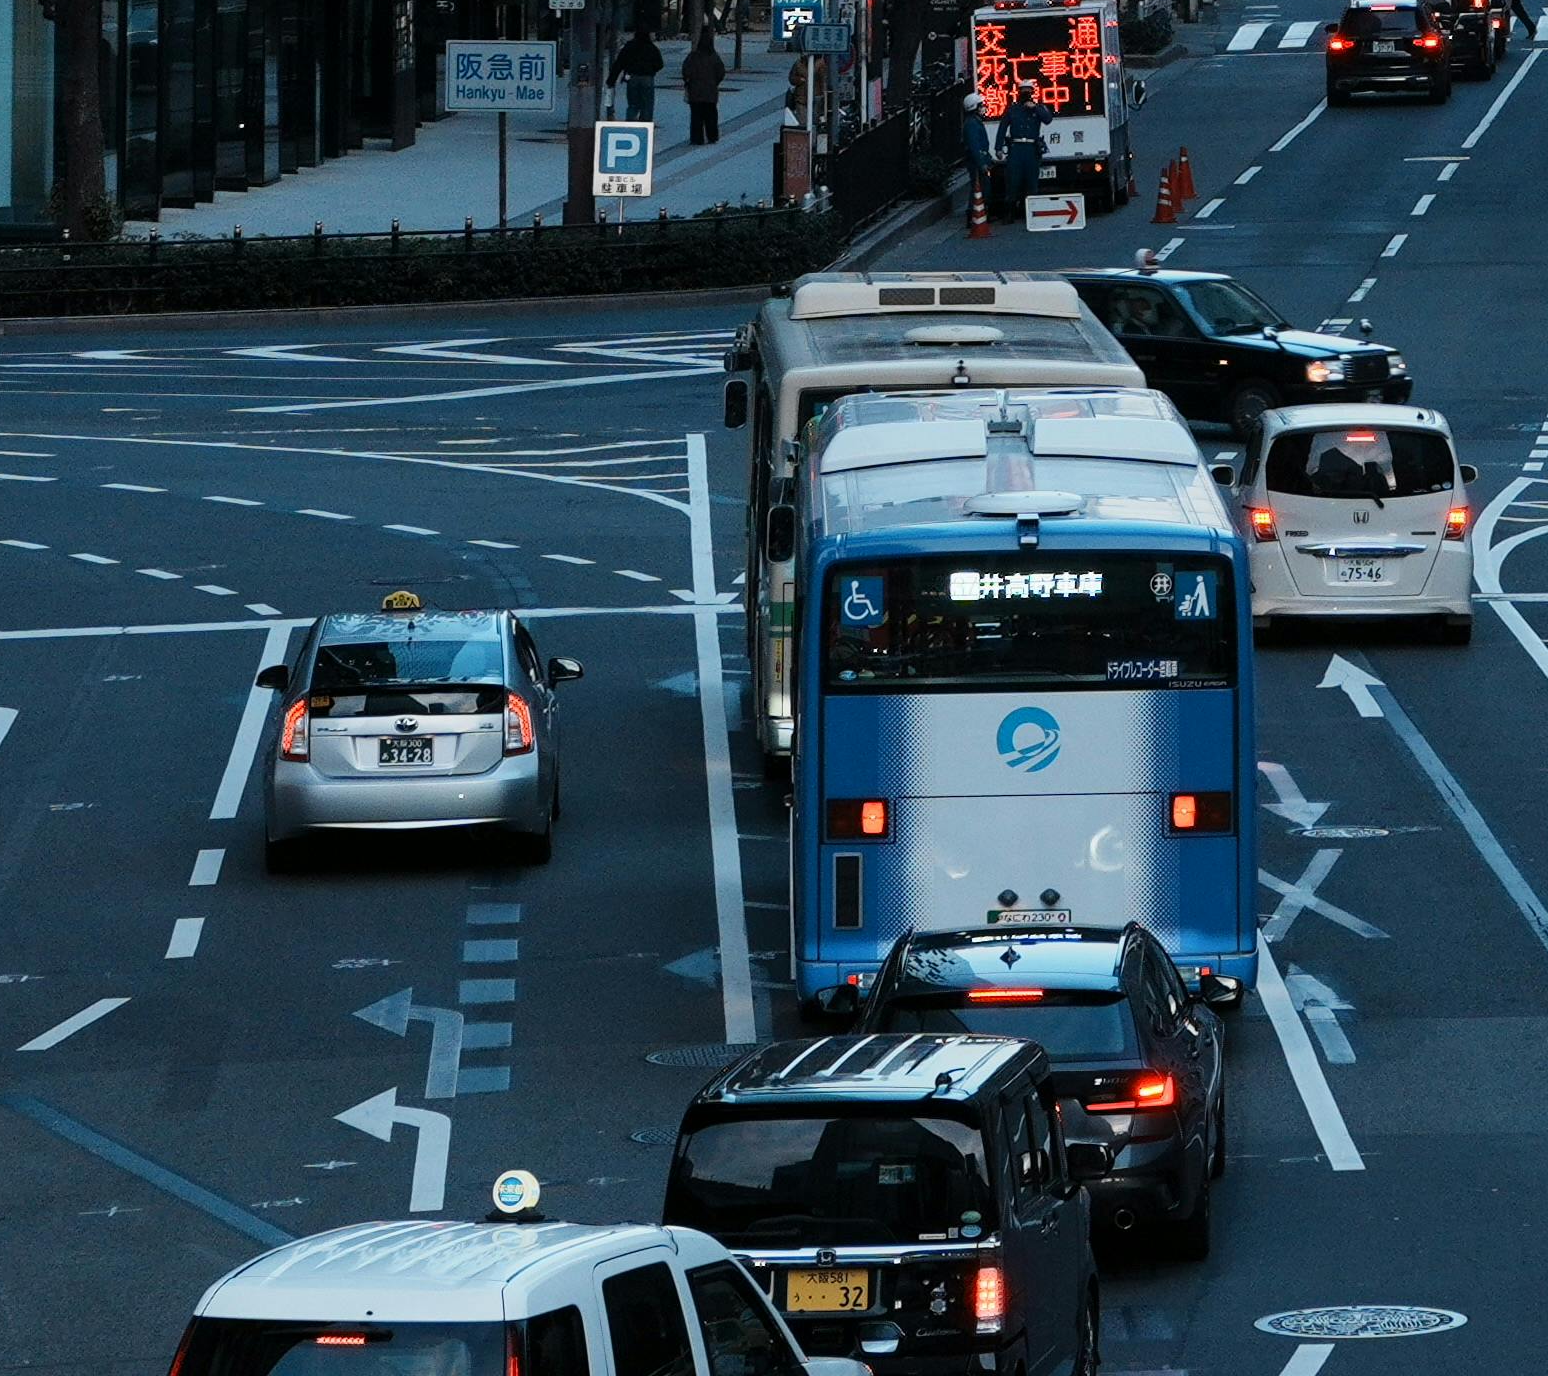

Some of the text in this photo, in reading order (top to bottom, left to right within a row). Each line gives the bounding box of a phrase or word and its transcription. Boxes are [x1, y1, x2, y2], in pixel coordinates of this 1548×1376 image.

[455, 53, 546, 82] 阪急前
[976, 49, 1102, 87] 死亡事故
[606, 133, 641, 168] P
[601, 182, 643, 194] 駐車場
[1348, 566, 1382, 581] 75-46
[1169, 679, 1202, 688] ISUZU
[391, 749, 432, 763] 34-28
[806, 1271, 850, 1285] 大阪581
[838, 1286, 864, 1308] 32
